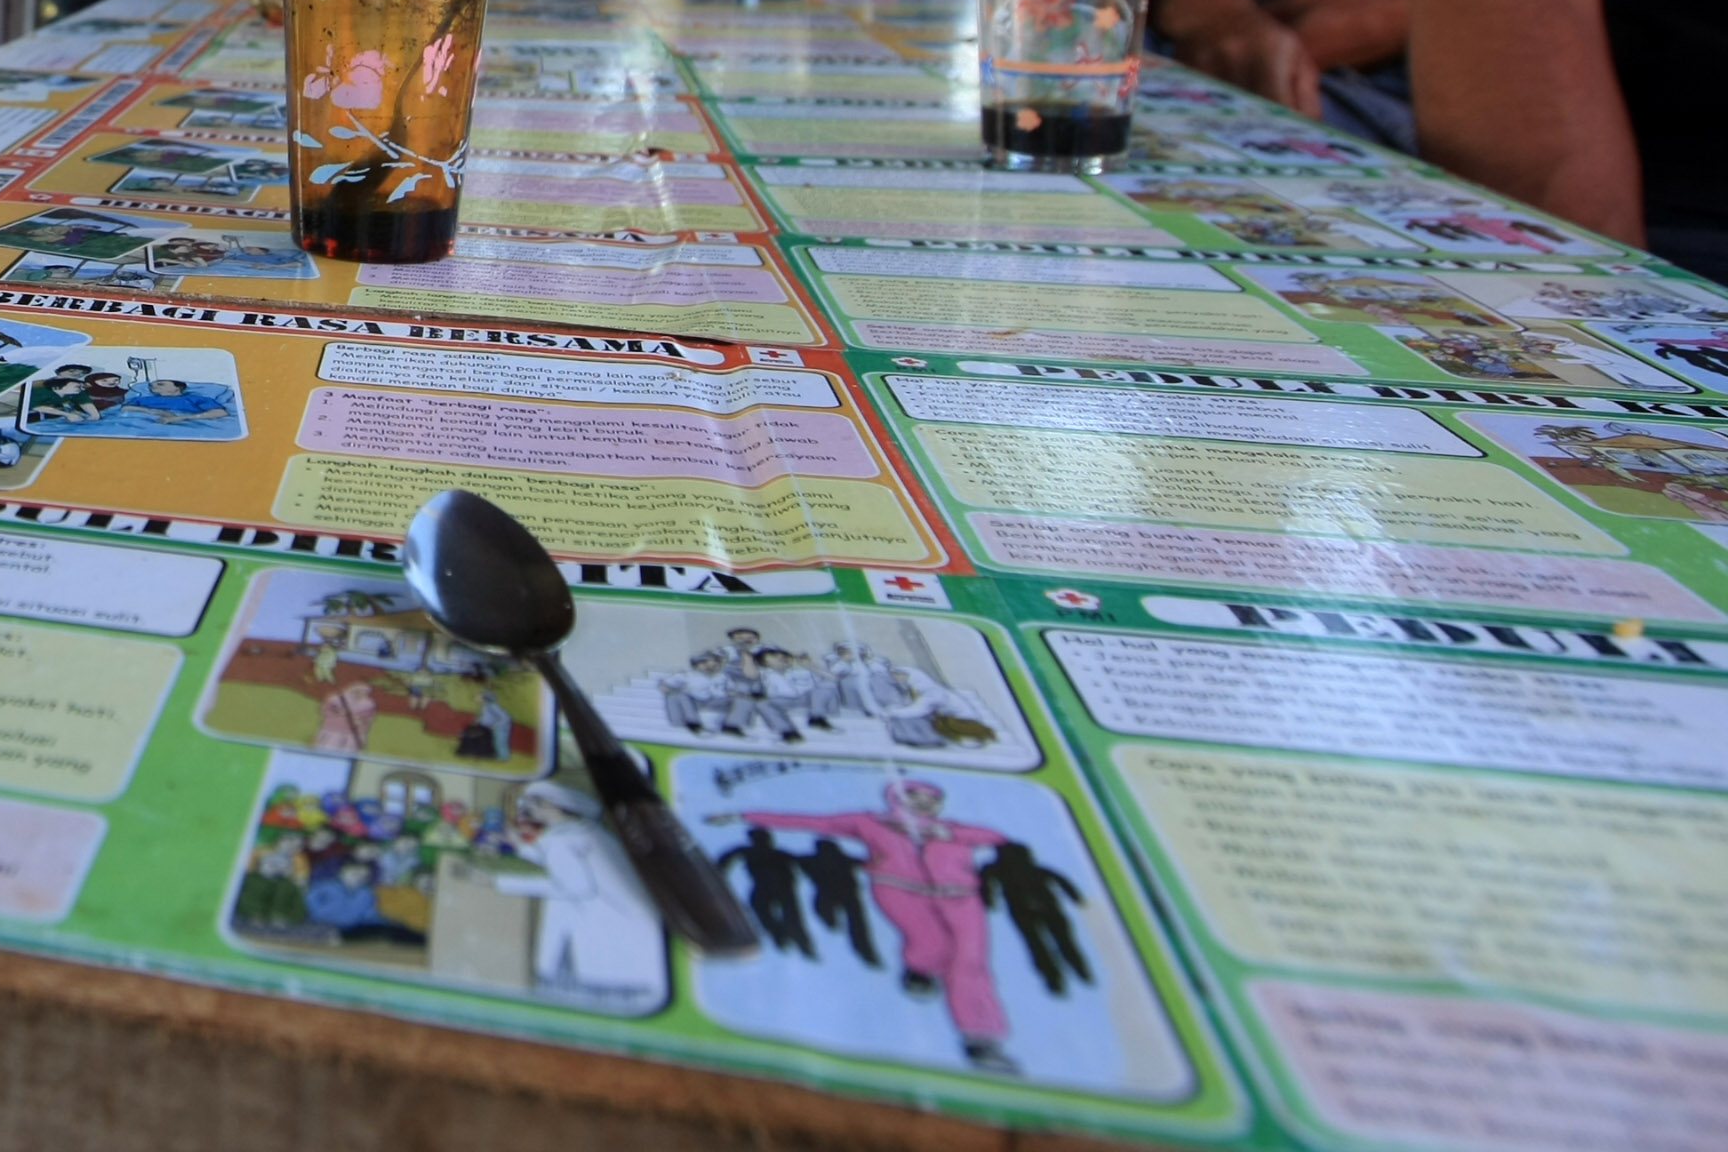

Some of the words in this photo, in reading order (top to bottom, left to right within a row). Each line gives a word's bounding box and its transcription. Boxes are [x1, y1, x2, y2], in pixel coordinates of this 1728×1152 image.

[238, 312, 385, 336] RASA
[407, 325, 687, 358] BERSAMA
[336, 344, 395, 355] Berbagi
[443, 353, 501, 362] adalah:
[328, 373, 383, 383] kondisi
[388, 378, 457, 389] menekan
[462, 383, 495, 392] bagi
[332, 359, 384, 369] mampu
[389, 363, 467, 374] mengatasi
[472, 369, 541, 380] berbagai
[547, 376, 655, 388] permasalahan
[439, 360, 511, 370] dukungan
[515, 365, 552, 374] pada
[557, 369, 601, 378] orang
[607, 371, 634, 379] lain
[330, 366, 411, 378] dialaminya
[416, 373, 444, 381] dan
[449, 375, 498, 384] keluar
[503, 379, 534, 388] dari
[541, 383, 593, 392] situasi
[612, 387, 679, 396] keadaan
[683, 392, 720, 405] yang
[764, 390, 802, 398] atau
[342, 393, 413, 404] Manfaat
[1015, 364, 1342, 395] PEDULI
[1369, 385, 1584, 411] DIRI
[1607, 399, 1728, 419] KI
[346, 417, 435, 431] Membantu
[440, 426, 488, 436] orang
[494, 430, 523, 438] lain
[528, 433, 577, 441] untuk
[582, 435, 648, 444] kembali
[348, 410, 433, 422] mengalami
[440, 417, 497, 427] kondisi
[503, 423, 542, 432] yang
[548, 426, 590, 434] lebih
[351, 401, 438, 415] Melindungi
[443, 409, 490, 419] orang
[495, 414, 533, 423] yang
[539, 418, 625, 427] mengalami
[631, 421, 709, 434] kesulitan
[344, 426, 414, 438] menjaga
[343, 432, 433, 447] Membantu
[439, 442, 488, 452] orang
[493, 446, 524, 454] lain
[528, 449, 646, 461] mendapatkan
[650, 454, 719, 466] kembali
[449, 450, 481, 459] ada
[326, 467, 454, 485] Mendengarkan
[460, 480, 523, 491] dengan
[528, 486, 566, 495] baik
[572, 489, 629, 500] ketika
[635, 493, 686, 501] orang
[692, 494, 734, 505] yang
[461, 472, 514, 482] dalam
[320, 485, 414, 500] dialaminya
[323, 476, 404, 490] kesulitan
[496, 492, 621, 509] menceritakan
[806, 500, 851, 511] yang
[313, 514, 394, 529] sehingga
[315, 503, 397, 518] Memberi
[318, 494, 408, 509] Menerima
[542, 516, 627, 529] perasaan
[633, 520, 676, 530] yang
[214, 525, 403, 563] DIR
[575, 563, 763, 594] ITA
[1224, 603, 1710, 664] PEDULI
